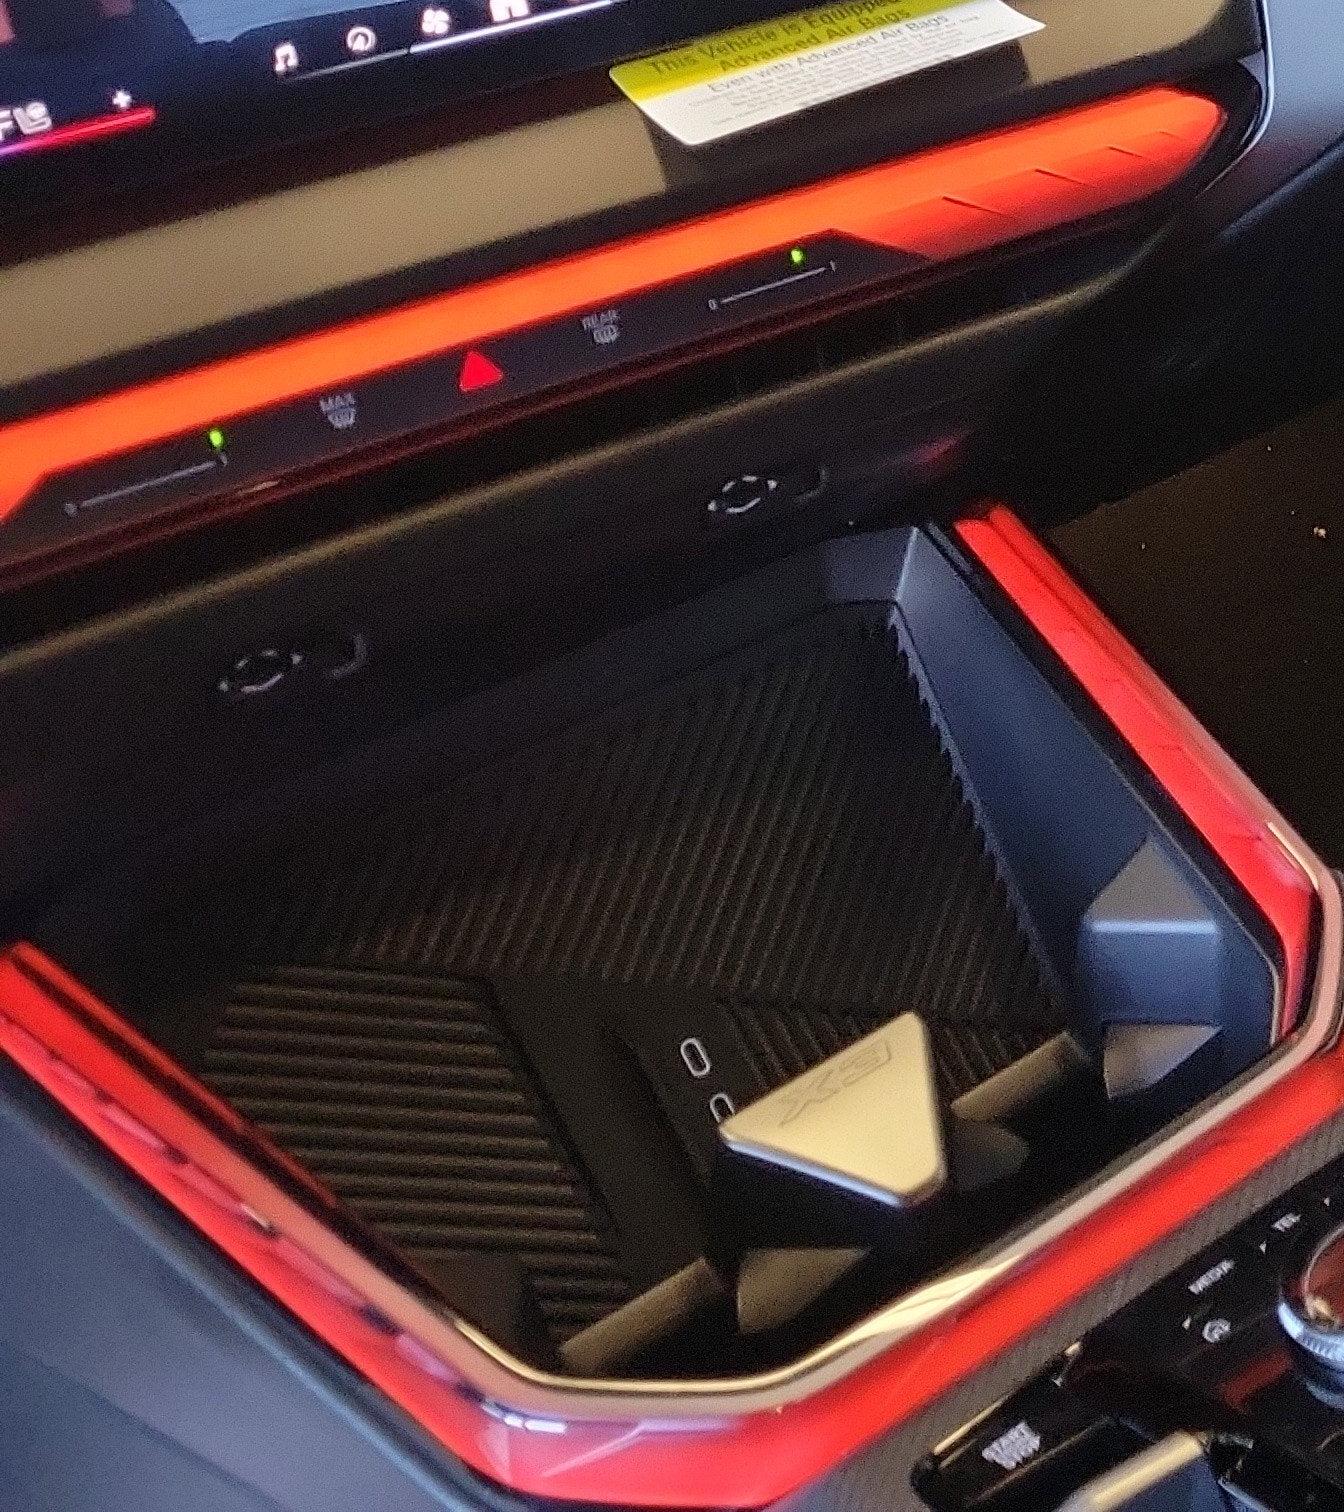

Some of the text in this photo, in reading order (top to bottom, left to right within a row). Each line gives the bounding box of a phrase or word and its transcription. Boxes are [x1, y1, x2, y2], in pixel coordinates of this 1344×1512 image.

[651, 54, 699, 75] This
[699, 29, 777, 60] Vehicle
[707, 15, 950, 93] Even with Advanced Air Bags
[719, 8, 911, 72] Advanced Air Bags
[778, 1039, 892, 1129] X3
[1188, 1258, 1236, 1295] MEDIA
